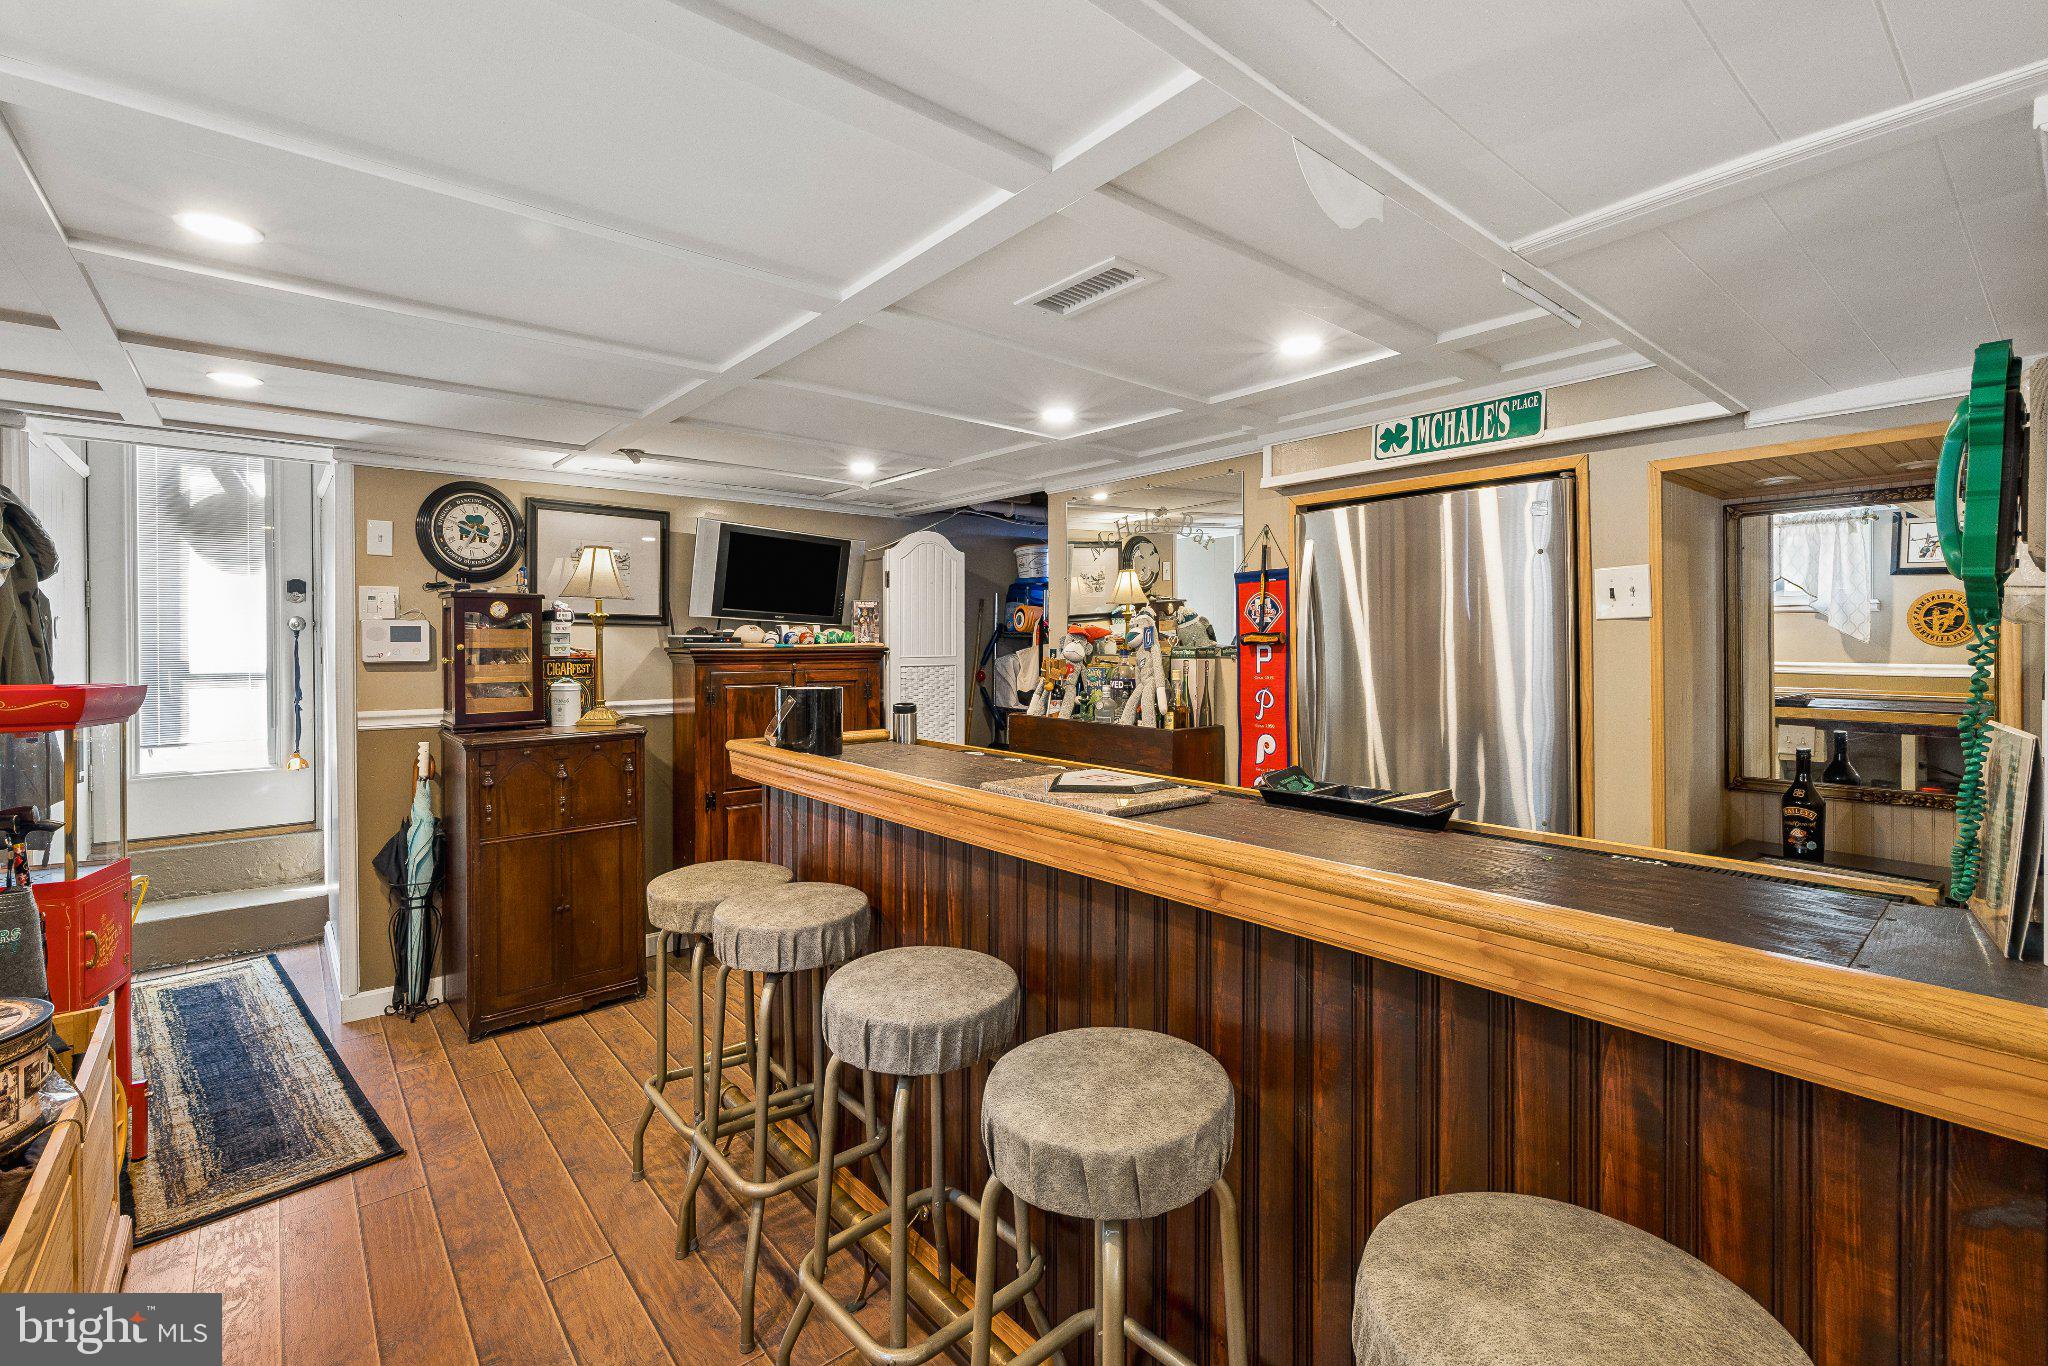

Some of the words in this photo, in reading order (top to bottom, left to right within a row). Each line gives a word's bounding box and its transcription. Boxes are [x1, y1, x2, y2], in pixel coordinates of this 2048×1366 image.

[1417, 401, 1511, 450] MCHALE'S
[1512, 395, 1539, 412] PLACE
[1177, 511, 1216, 551] Bar
[547, 661, 591, 676] CIGARFEST
[1256, 645, 1272, 674] P
[1255, 687, 1275, 721] P
[1255, 734, 1277, 765] P
